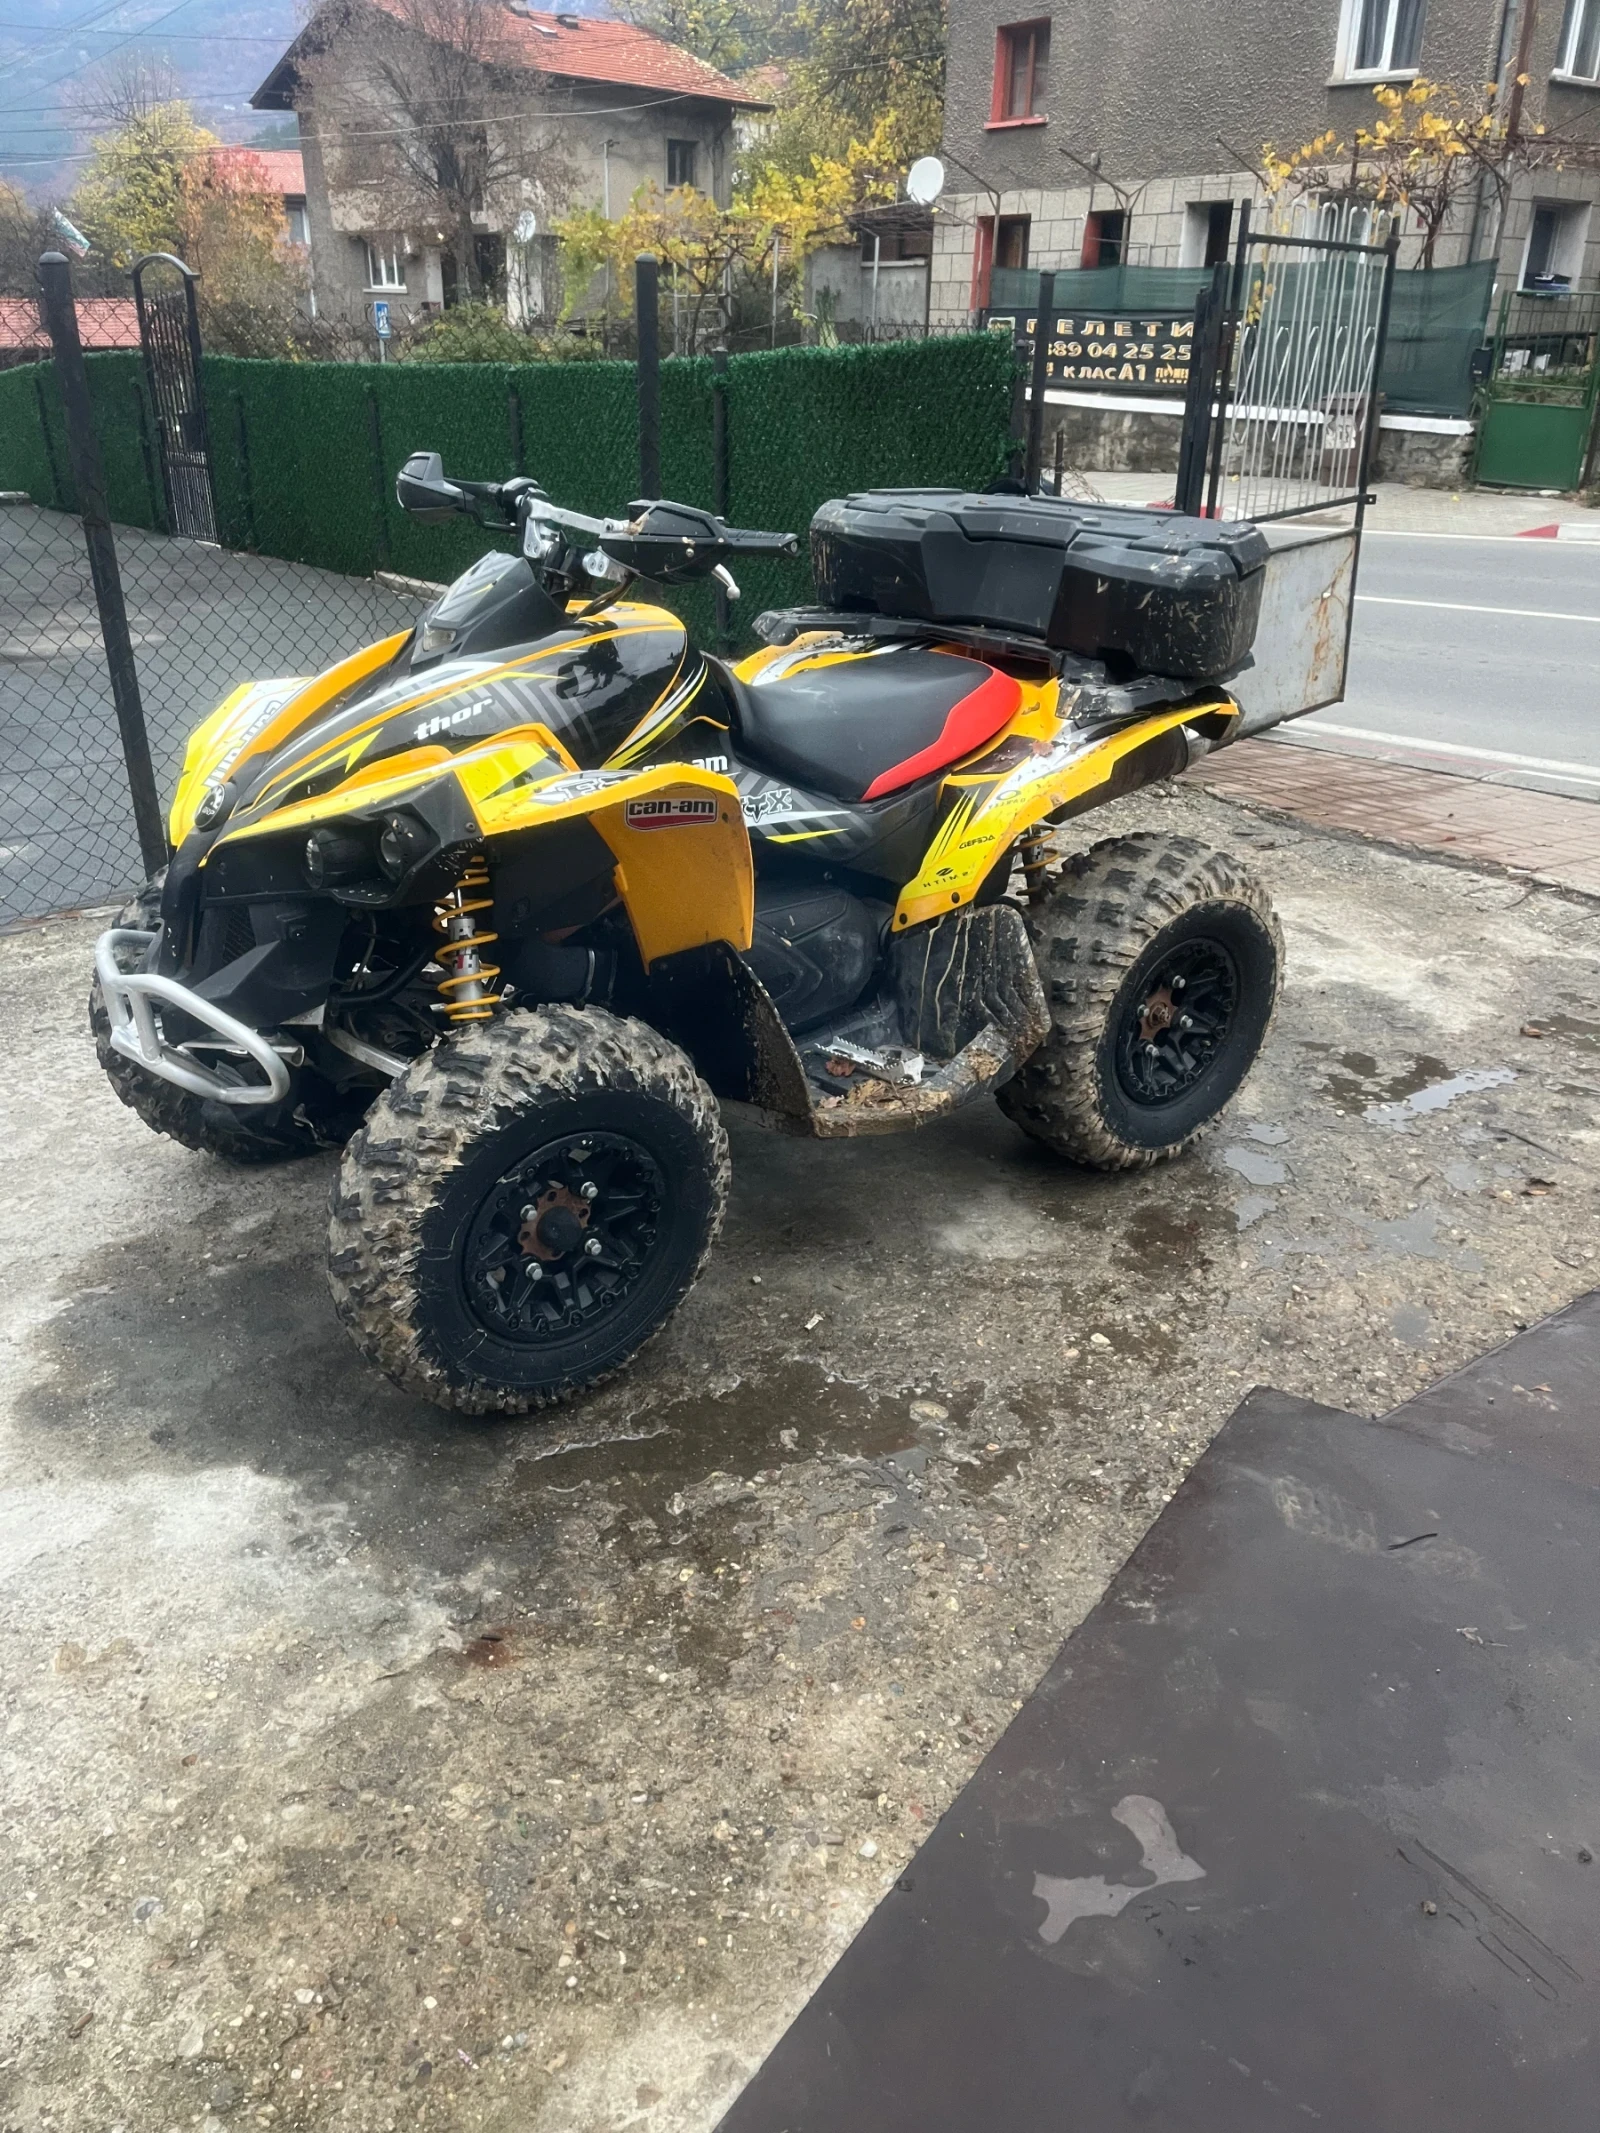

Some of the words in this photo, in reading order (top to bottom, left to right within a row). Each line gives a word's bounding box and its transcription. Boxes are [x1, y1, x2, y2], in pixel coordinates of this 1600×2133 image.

[1087, 342, 1117, 358] 04
[1123, 343, 1154, 359] 25
[1160, 344, 1192, 360] 25
[413, 698, 493, 740] thor
[628, 800, 714, 816] can-am
